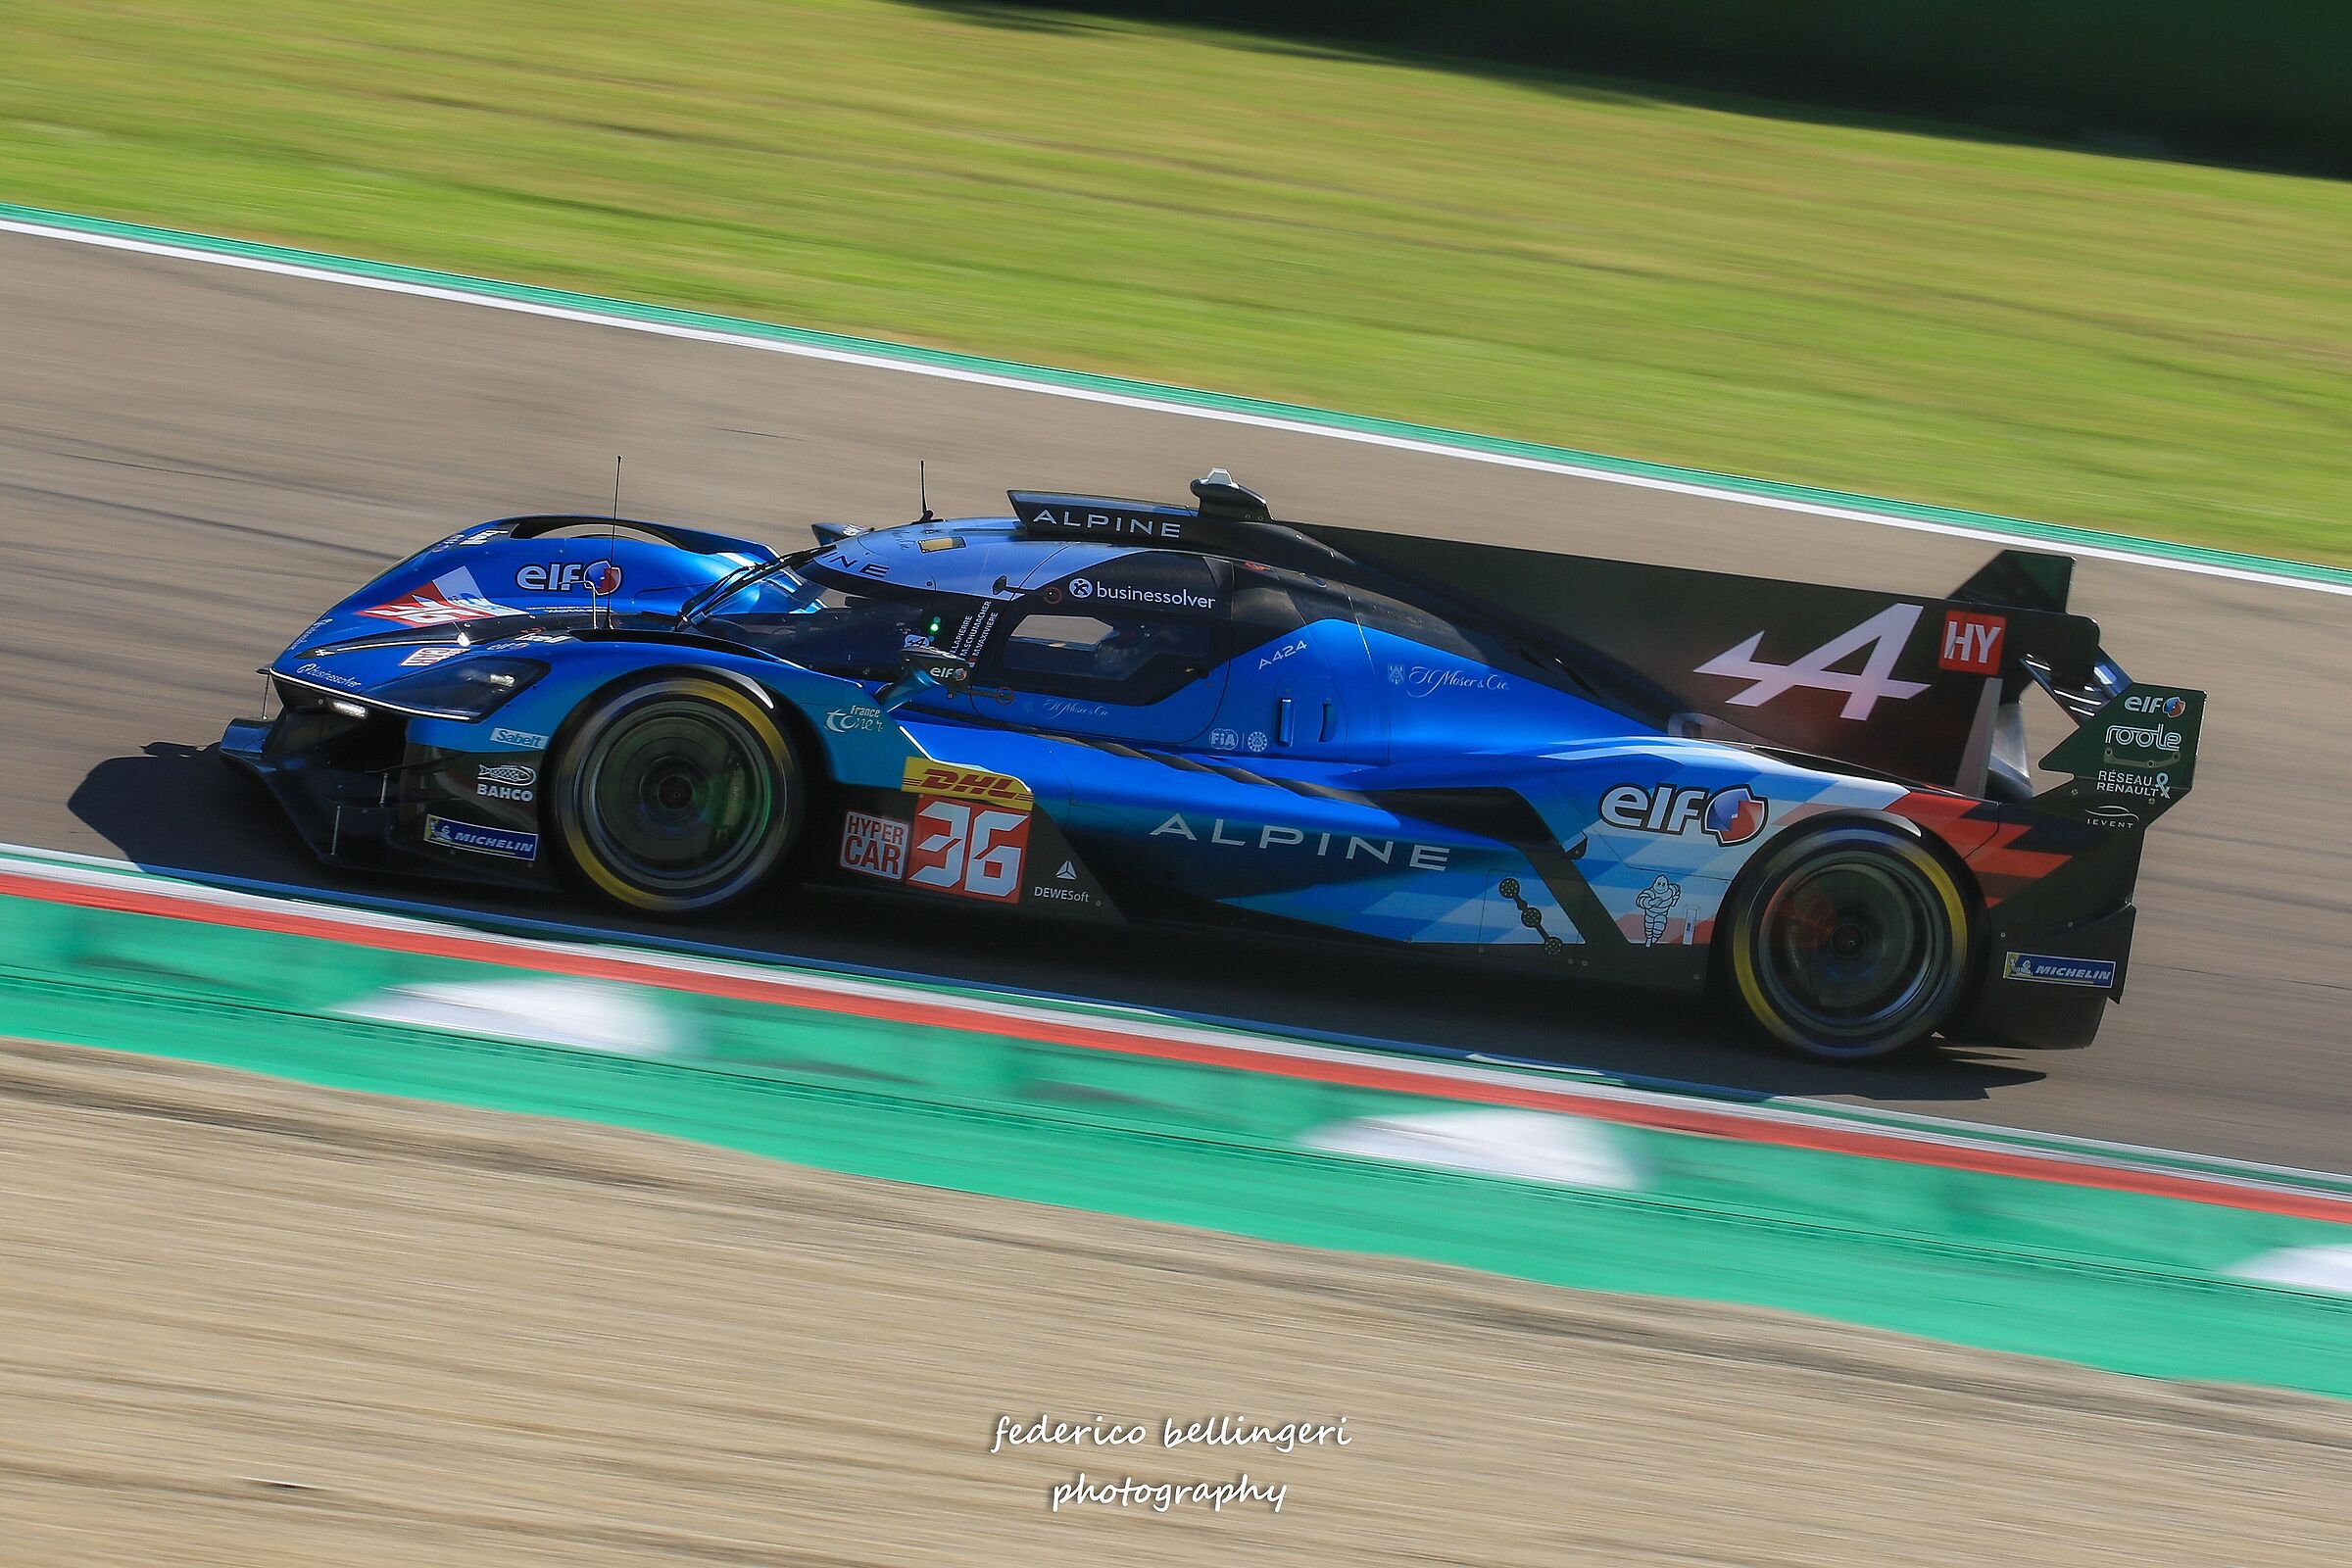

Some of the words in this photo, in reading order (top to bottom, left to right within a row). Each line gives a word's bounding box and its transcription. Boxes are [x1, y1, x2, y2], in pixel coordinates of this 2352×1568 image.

[1033, 509, 1181, 538] ALPINE
[516, 564, 581, 590] elf
[1097, 581, 1215, 609] businessolver
[1944, 620, 2001, 663] HY
[1258, 640, 1307, 670] A424
[930, 667, 954, 678] elf
[851, 705, 881, 717] France
[2124, 696, 2163, 713] elf
[497, 730, 542, 747] Sabelt
[2105, 723, 2181, 752] roole
[919, 768, 1018, 800] DHL
[2096, 782, 2159, 797] RENAULT
[2098, 769, 2153, 786] RÉSEAU
[476, 784, 534, 802] BAHCO
[1601, 786, 1705, 832] elf
[848, 815, 904, 846] HYPER
[2086, 818, 2133, 829] IEVENT
[455, 832, 534, 853] MICHELIN
[844, 835, 902, 875] CAR
[908, 801, 1029, 897] 36
[1150, 813, 1450, 872] ALPINE
[1034, 886, 1090, 903] DEWESoft
[2034, 965, 2111, 980] MICHELIN
